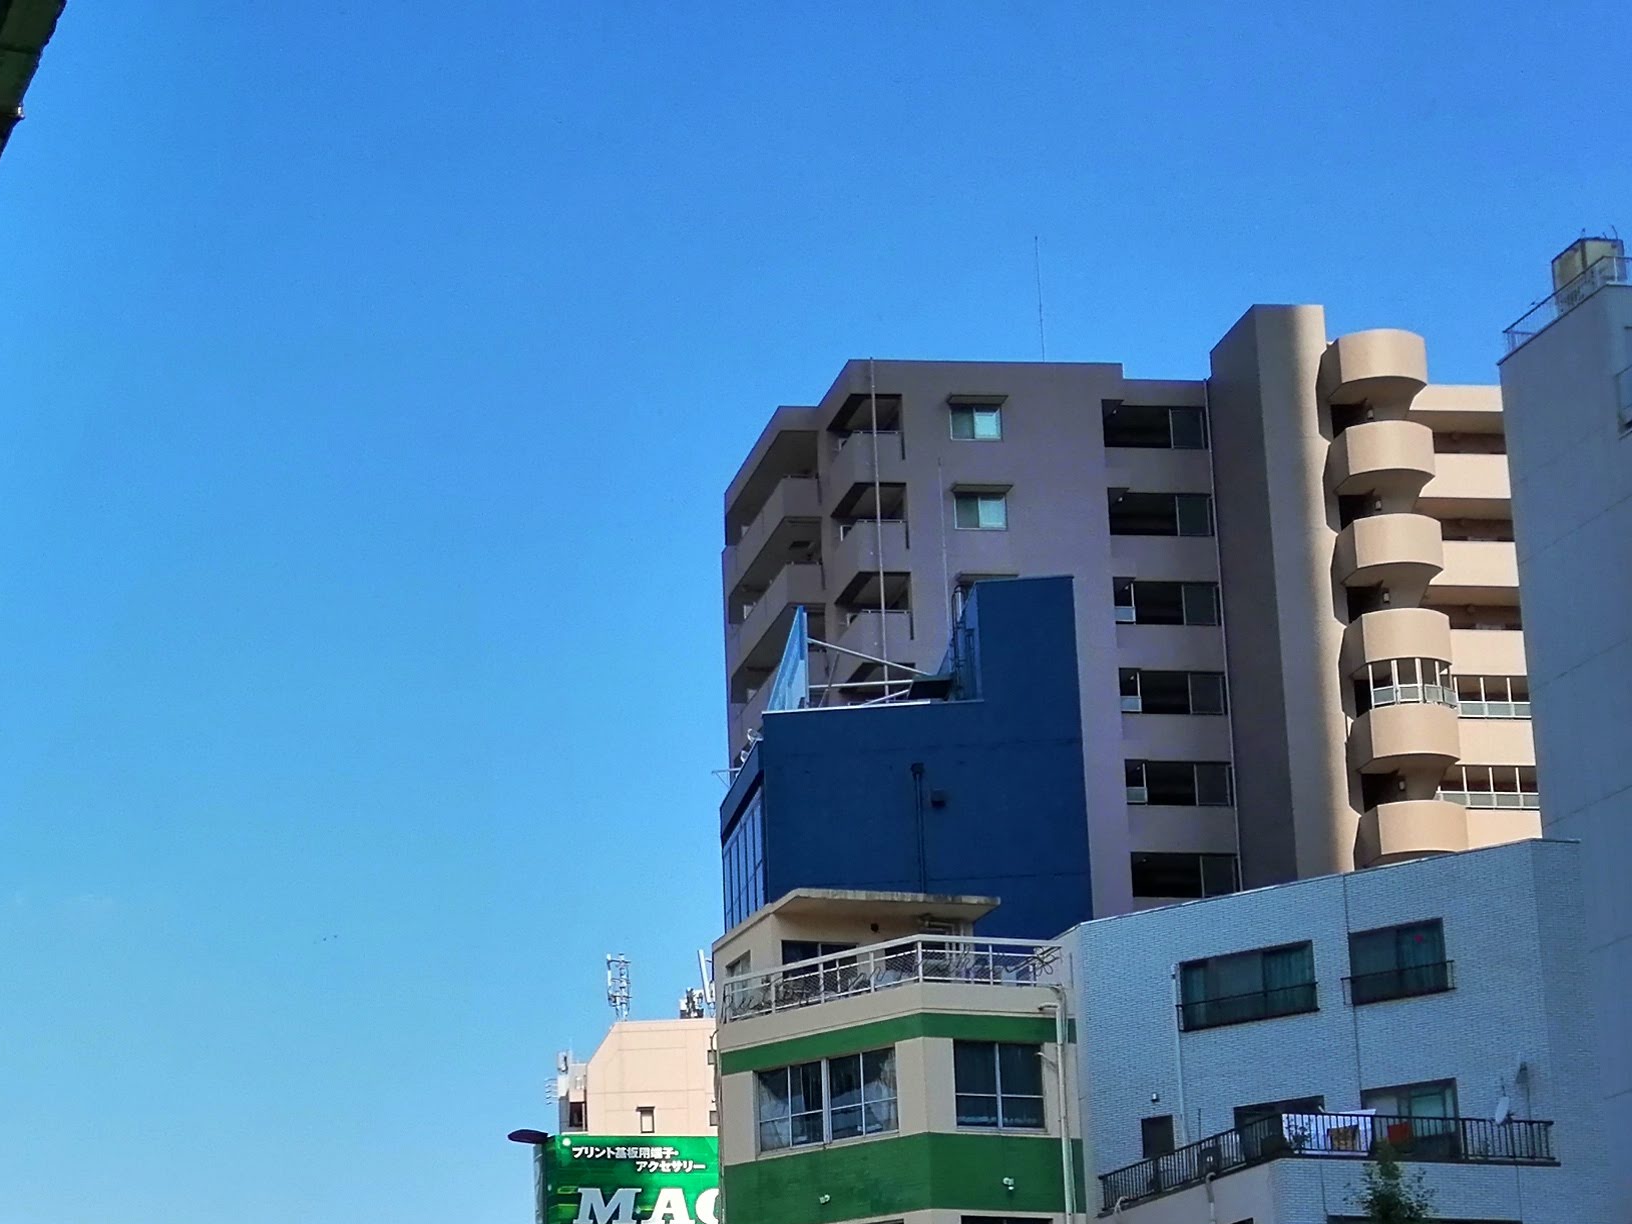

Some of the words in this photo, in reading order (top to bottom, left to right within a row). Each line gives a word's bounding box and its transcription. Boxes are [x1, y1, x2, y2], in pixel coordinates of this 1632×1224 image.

[636, 1160, 706, 1173] アクセサリー
